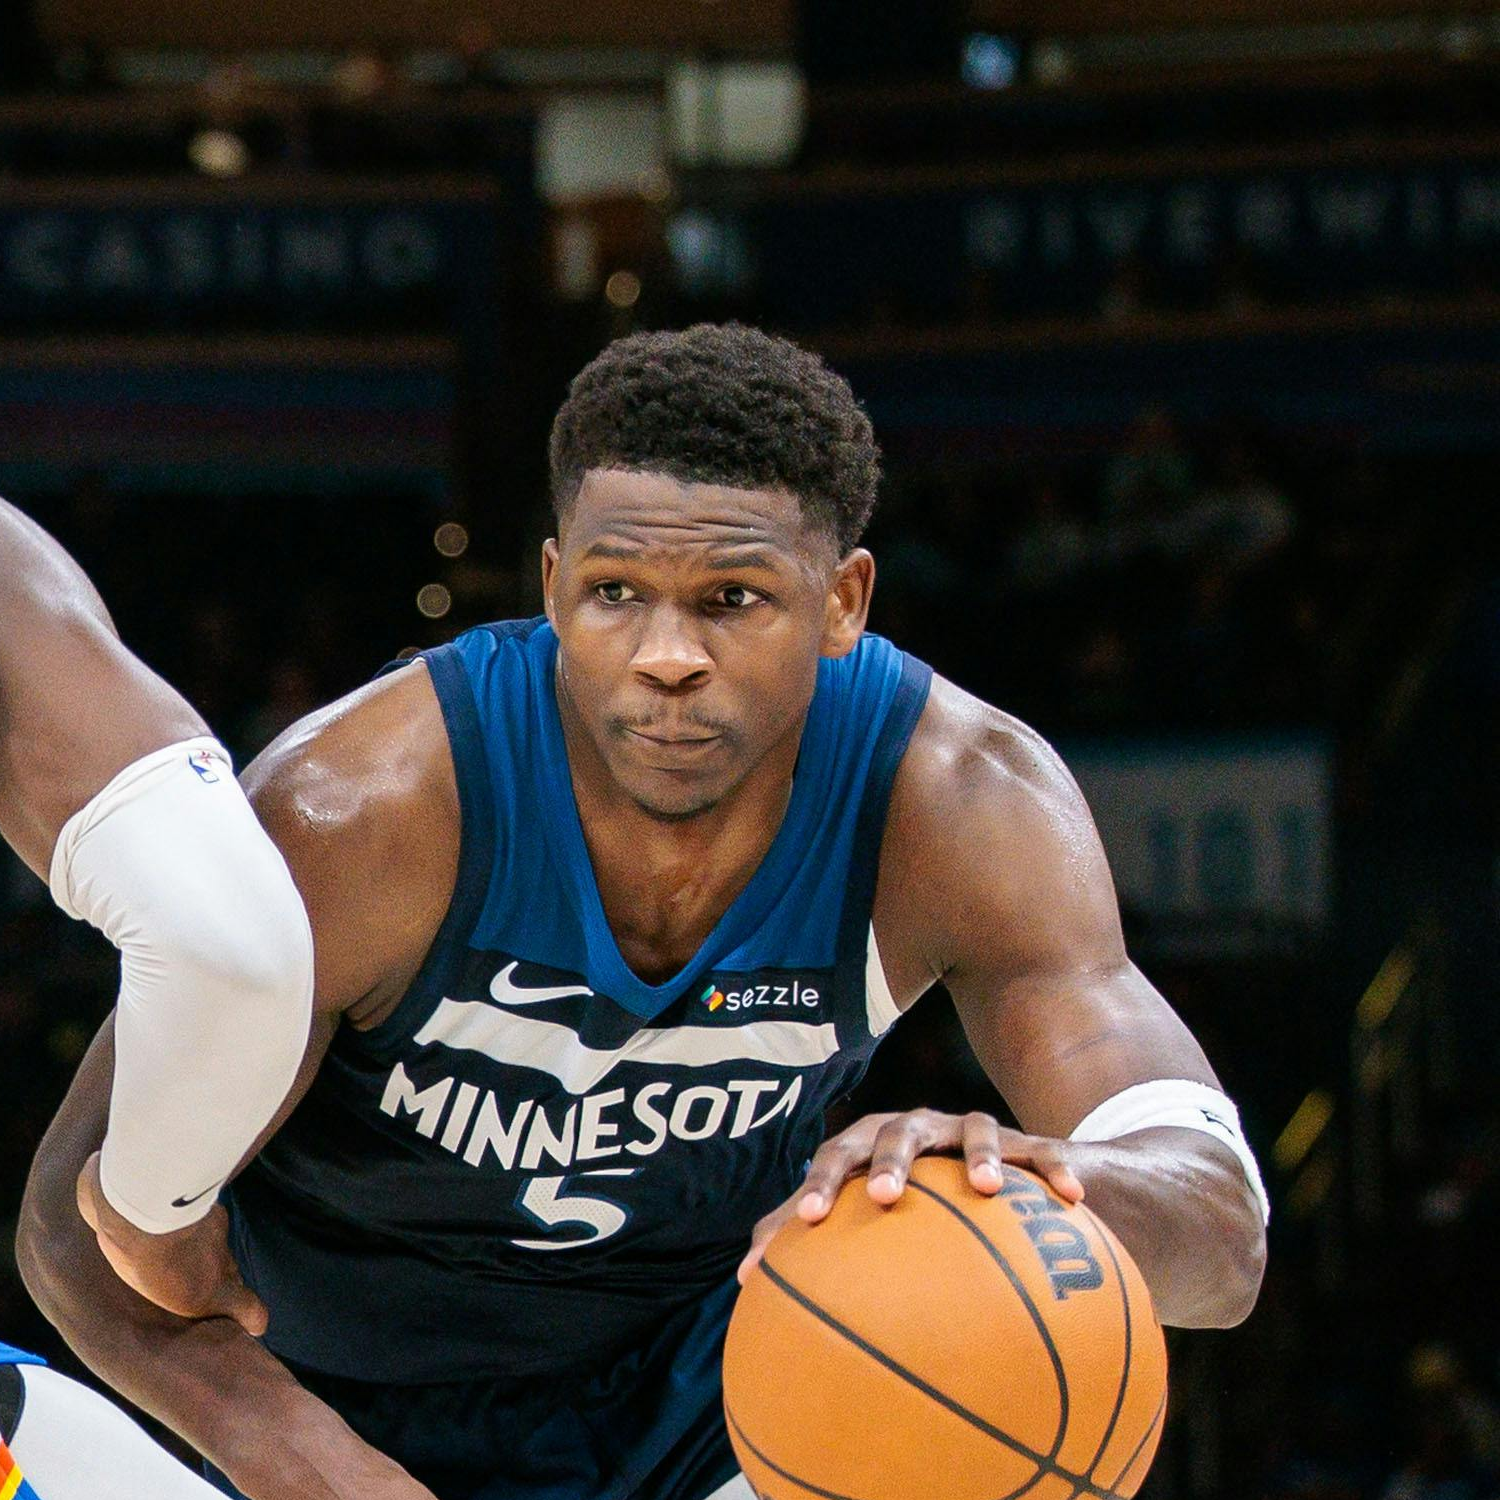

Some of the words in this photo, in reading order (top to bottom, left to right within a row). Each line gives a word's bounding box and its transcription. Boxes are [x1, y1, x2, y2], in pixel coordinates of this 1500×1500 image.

[725, 980, 820, 1011] sezzle
[379, 1061, 803, 1171] MINNESOTA
[508, 1166, 646, 1251] 5
